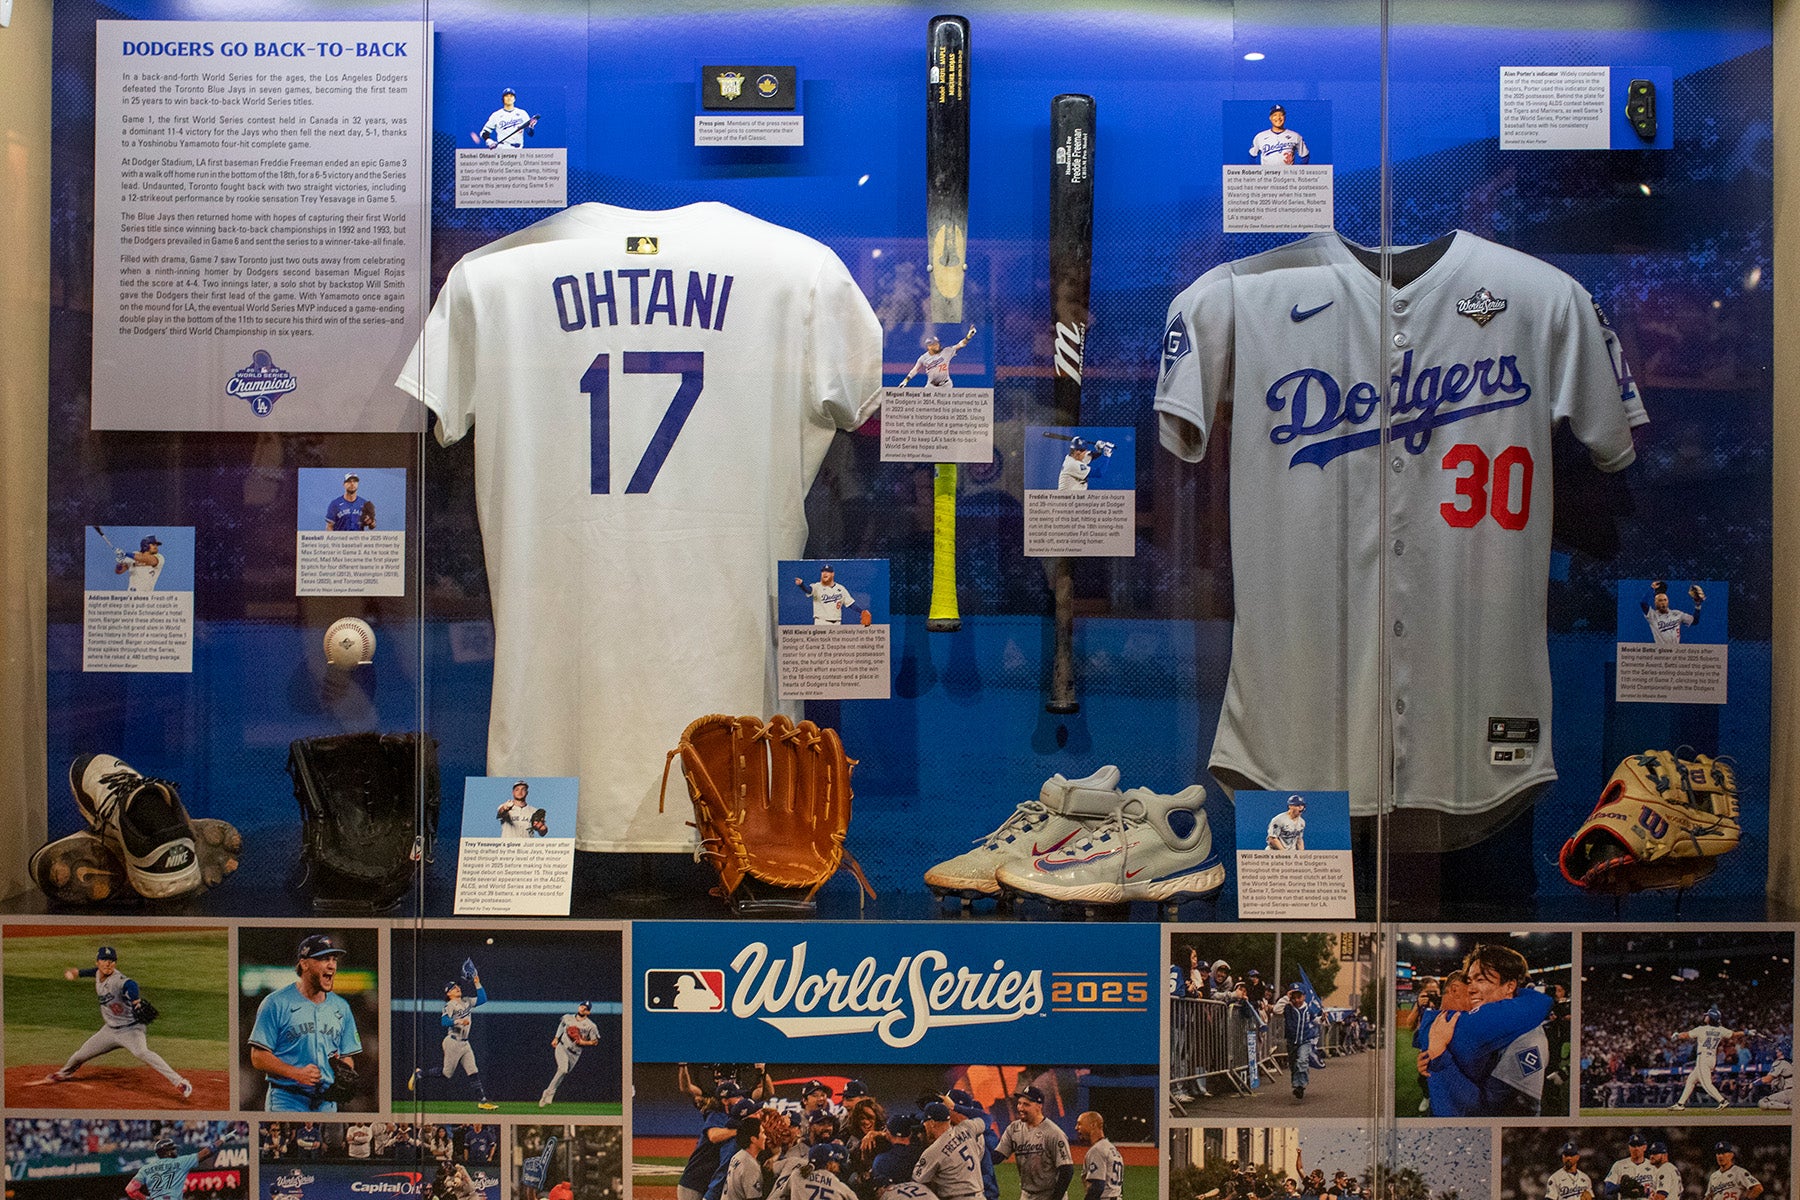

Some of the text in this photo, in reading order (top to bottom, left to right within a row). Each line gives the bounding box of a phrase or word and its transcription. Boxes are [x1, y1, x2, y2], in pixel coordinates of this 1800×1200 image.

[123, 42, 407, 57] DODGERS GO BACK-TO-BACK
[286, 75, 306, 83] ages,
[342, 73, 372, 83] Angeles
[376, 73, 407, 83] Dodgers
[228, 85, 246, 95] Jays
[285, 87, 312, 95] games,
[316, 85, 352, 95] becoming
[142, 98, 163, 106] years
[252, 140, 286, 150] complete
[288, 142, 311, 150] game.
[1071, 128, 1082, 183] Freddie Freeman
[552, 269, 734, 332] OHTANI
[134, 327, 167, 337] Dodgers'
[214, 328, 267, 338] Championship
[291, 330, 313, 338] years.
[1168, 331, 1182, 353] G
[227, 378, 296, 395] Champions
[257, 399, 267, 413] LA
[1266, 350, 1531, 458] Dodgers
[580, 351, 704, 494] 17
[1440, 444, 1534, 531] 30
[165, 851, 189, 868] NIKE
[730, 941, 1148, 1048] World Series 2025
[286, 1022, 316, 1040] BLUE
[1703, 1037, 1720, 1050] 47
[941, 1130, 972, 1157] FREEMAN
[1011, 1140, 1044, 1153] Dodgers
[214, 1148, 248, 1168] ANA
[958, 1145, 975, 1171] 5
[152, 1172, 176, 1192] 27
[351, 1181, 401, 1194] Capital
[809, 1174, 832, 1186] DEAN
[805, 1184, 834, 1200] 75
[897, 1186, 927, 1198] 12
